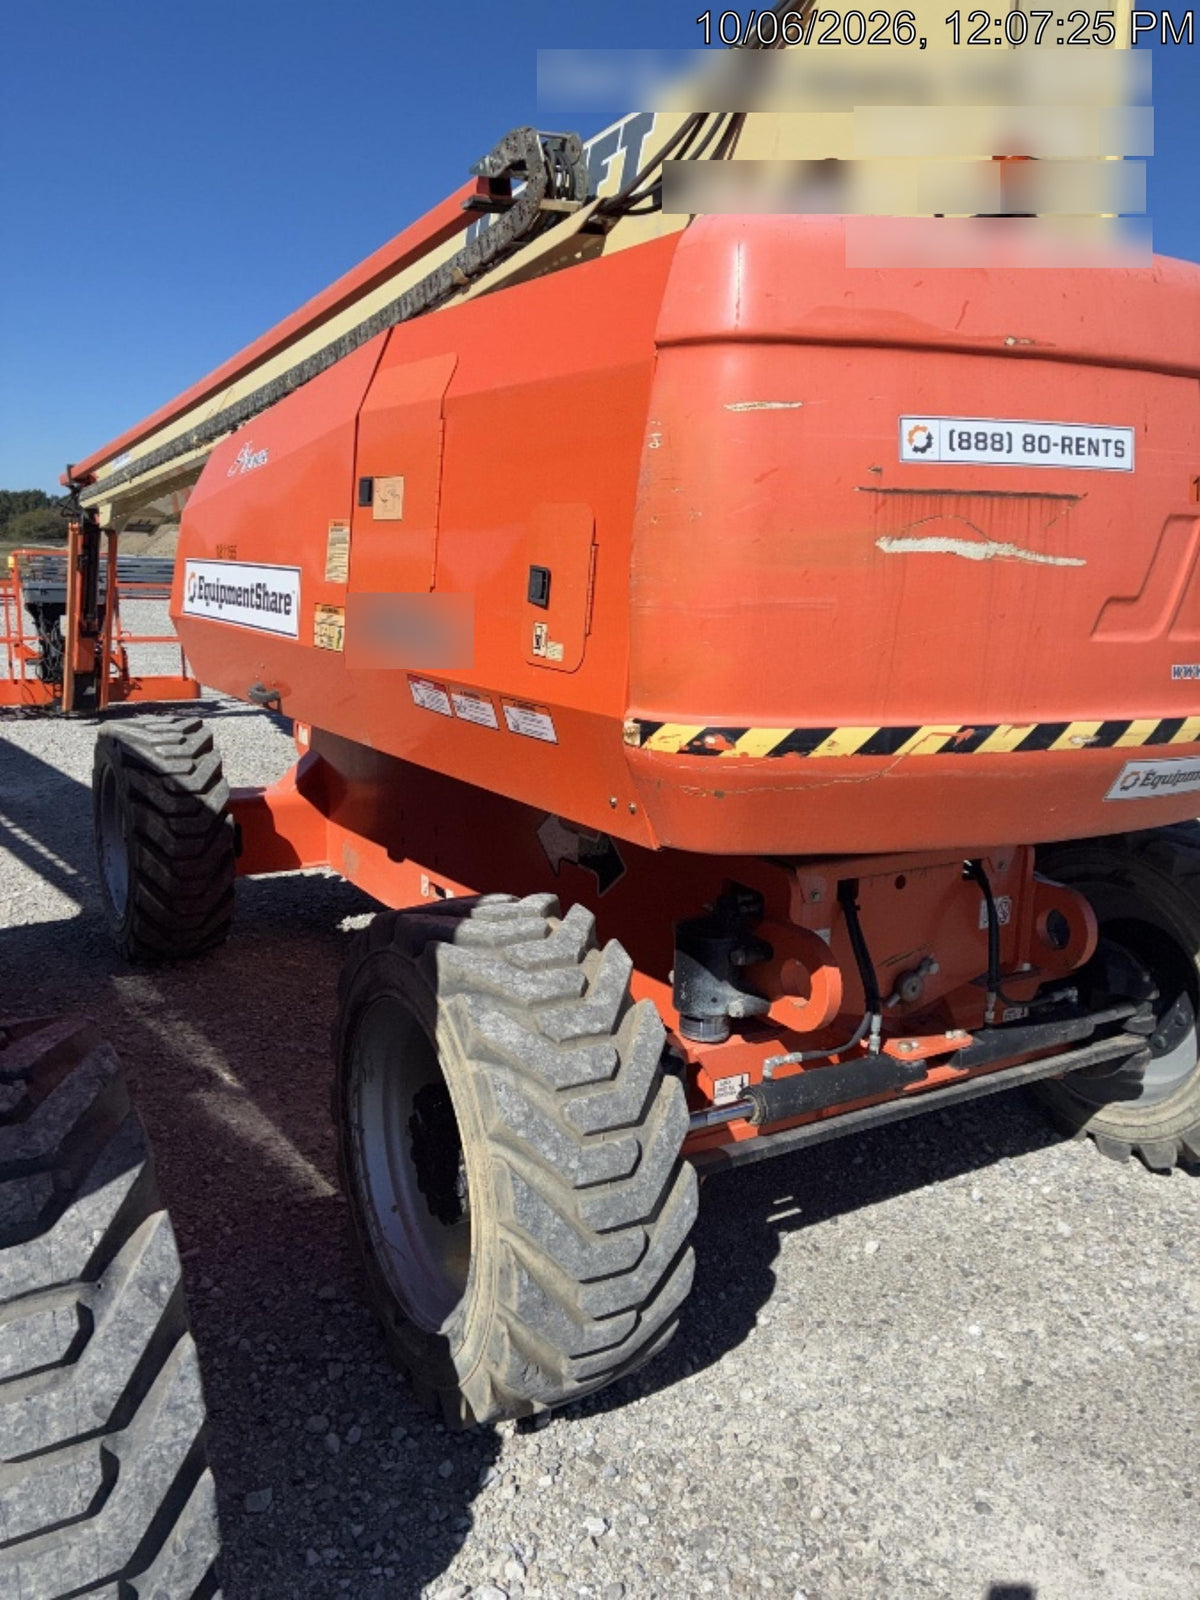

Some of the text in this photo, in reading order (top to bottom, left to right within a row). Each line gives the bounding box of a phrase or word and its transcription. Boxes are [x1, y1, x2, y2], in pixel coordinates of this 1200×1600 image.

[948, 429, 1126, 458] (888) 80-RENTS
[197, 575, 293, 616] EquipmentShare
